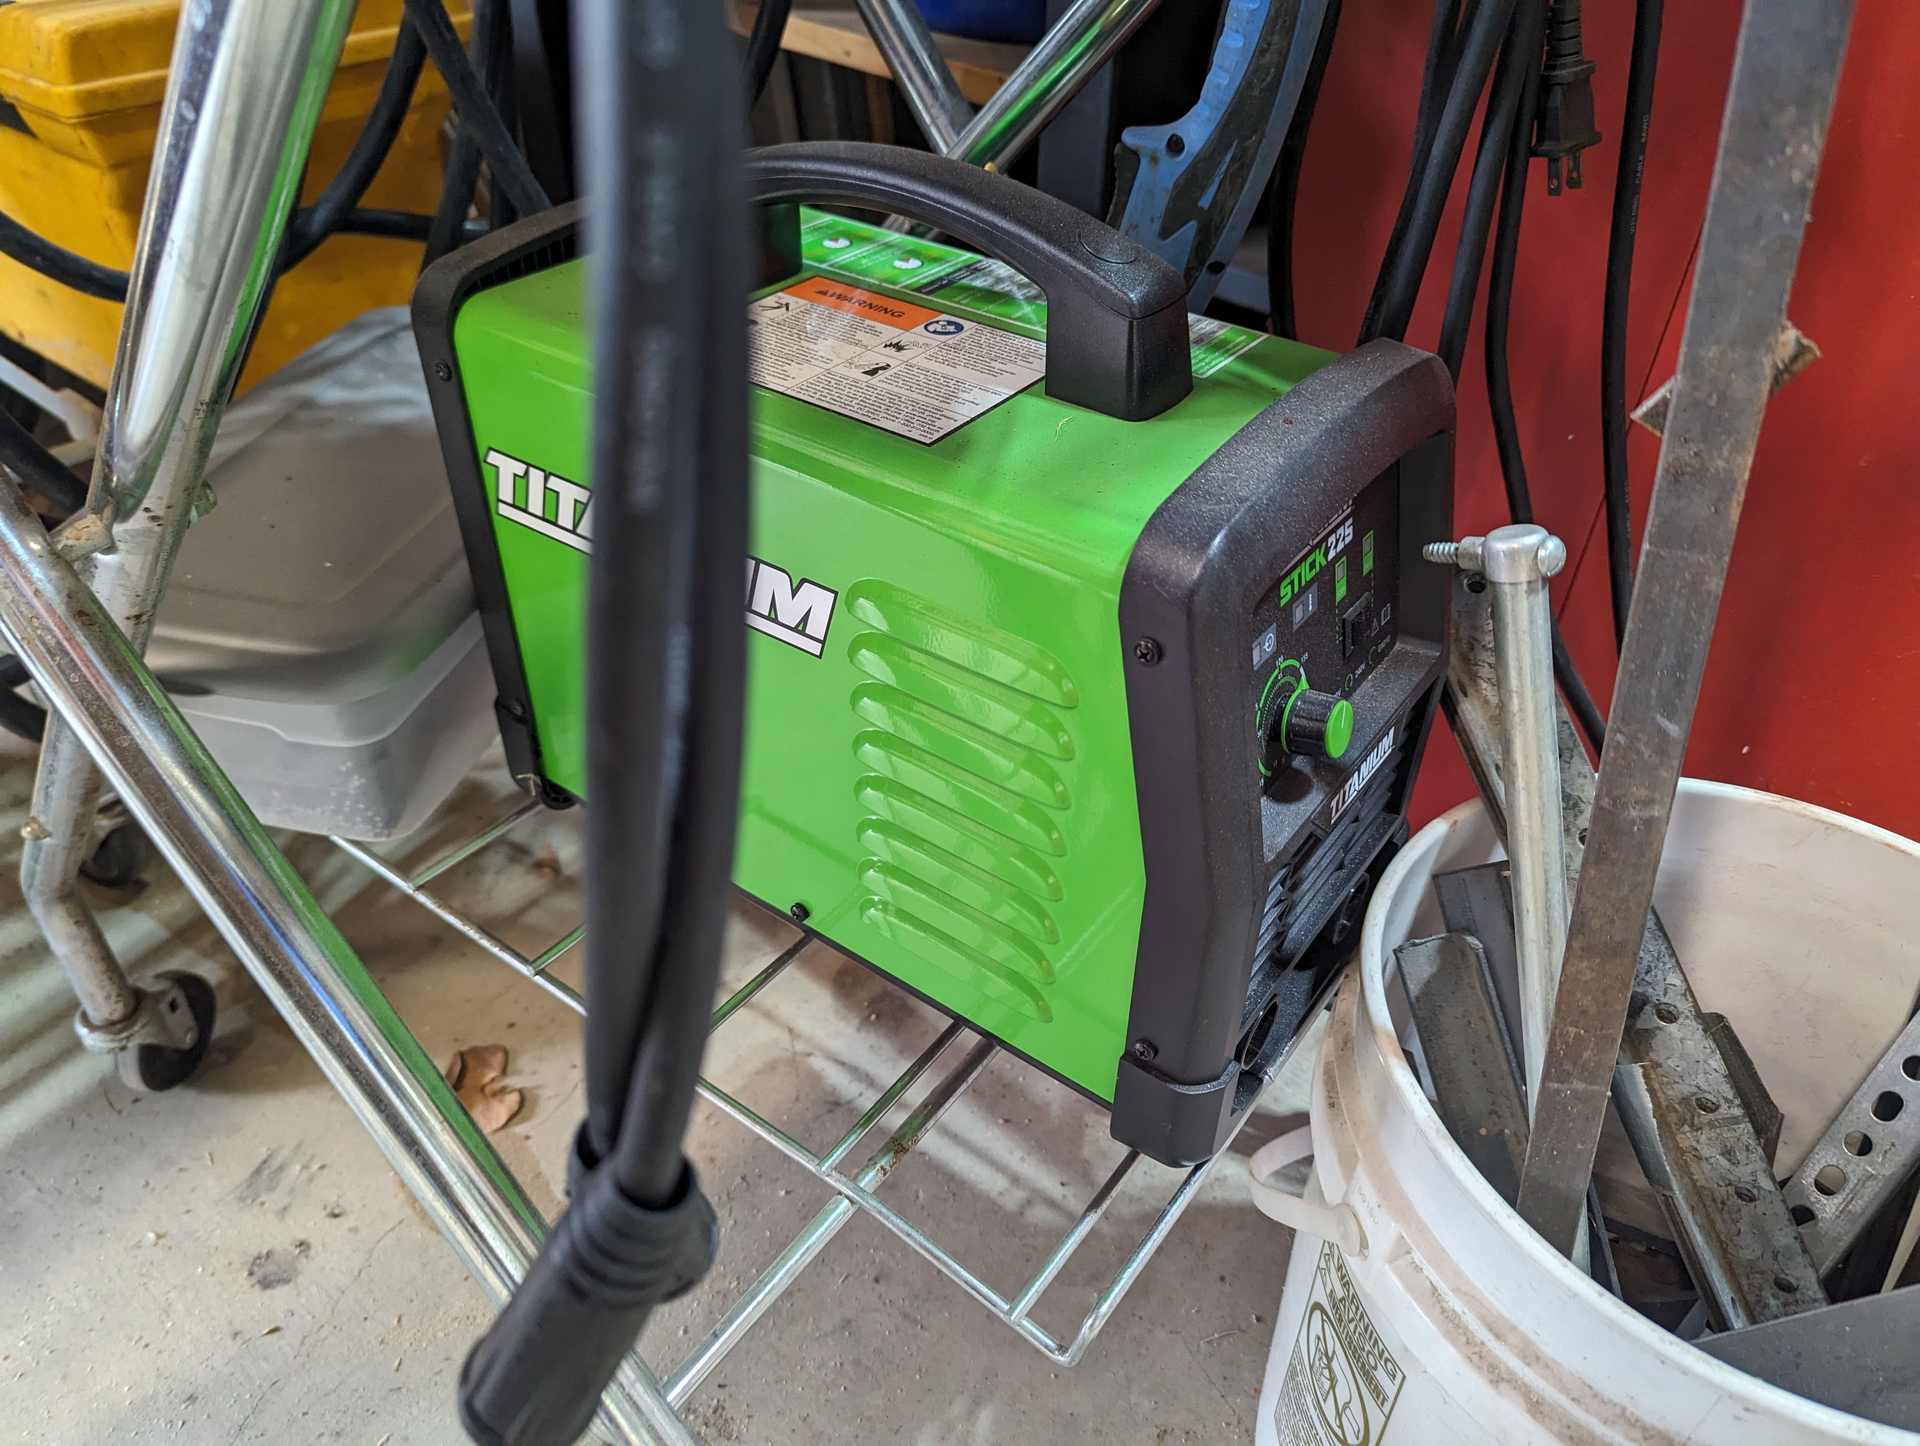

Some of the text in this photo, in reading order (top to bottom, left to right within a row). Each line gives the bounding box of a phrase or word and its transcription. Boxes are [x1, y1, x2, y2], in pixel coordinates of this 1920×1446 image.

[828, 292, 905, 319] WARNING
[1330, 726, 1395, 820] TITANIUM
[1336, 1254, 1398, 1381] WARNING
[1339, 1295, 1378, 1372] AVISO
